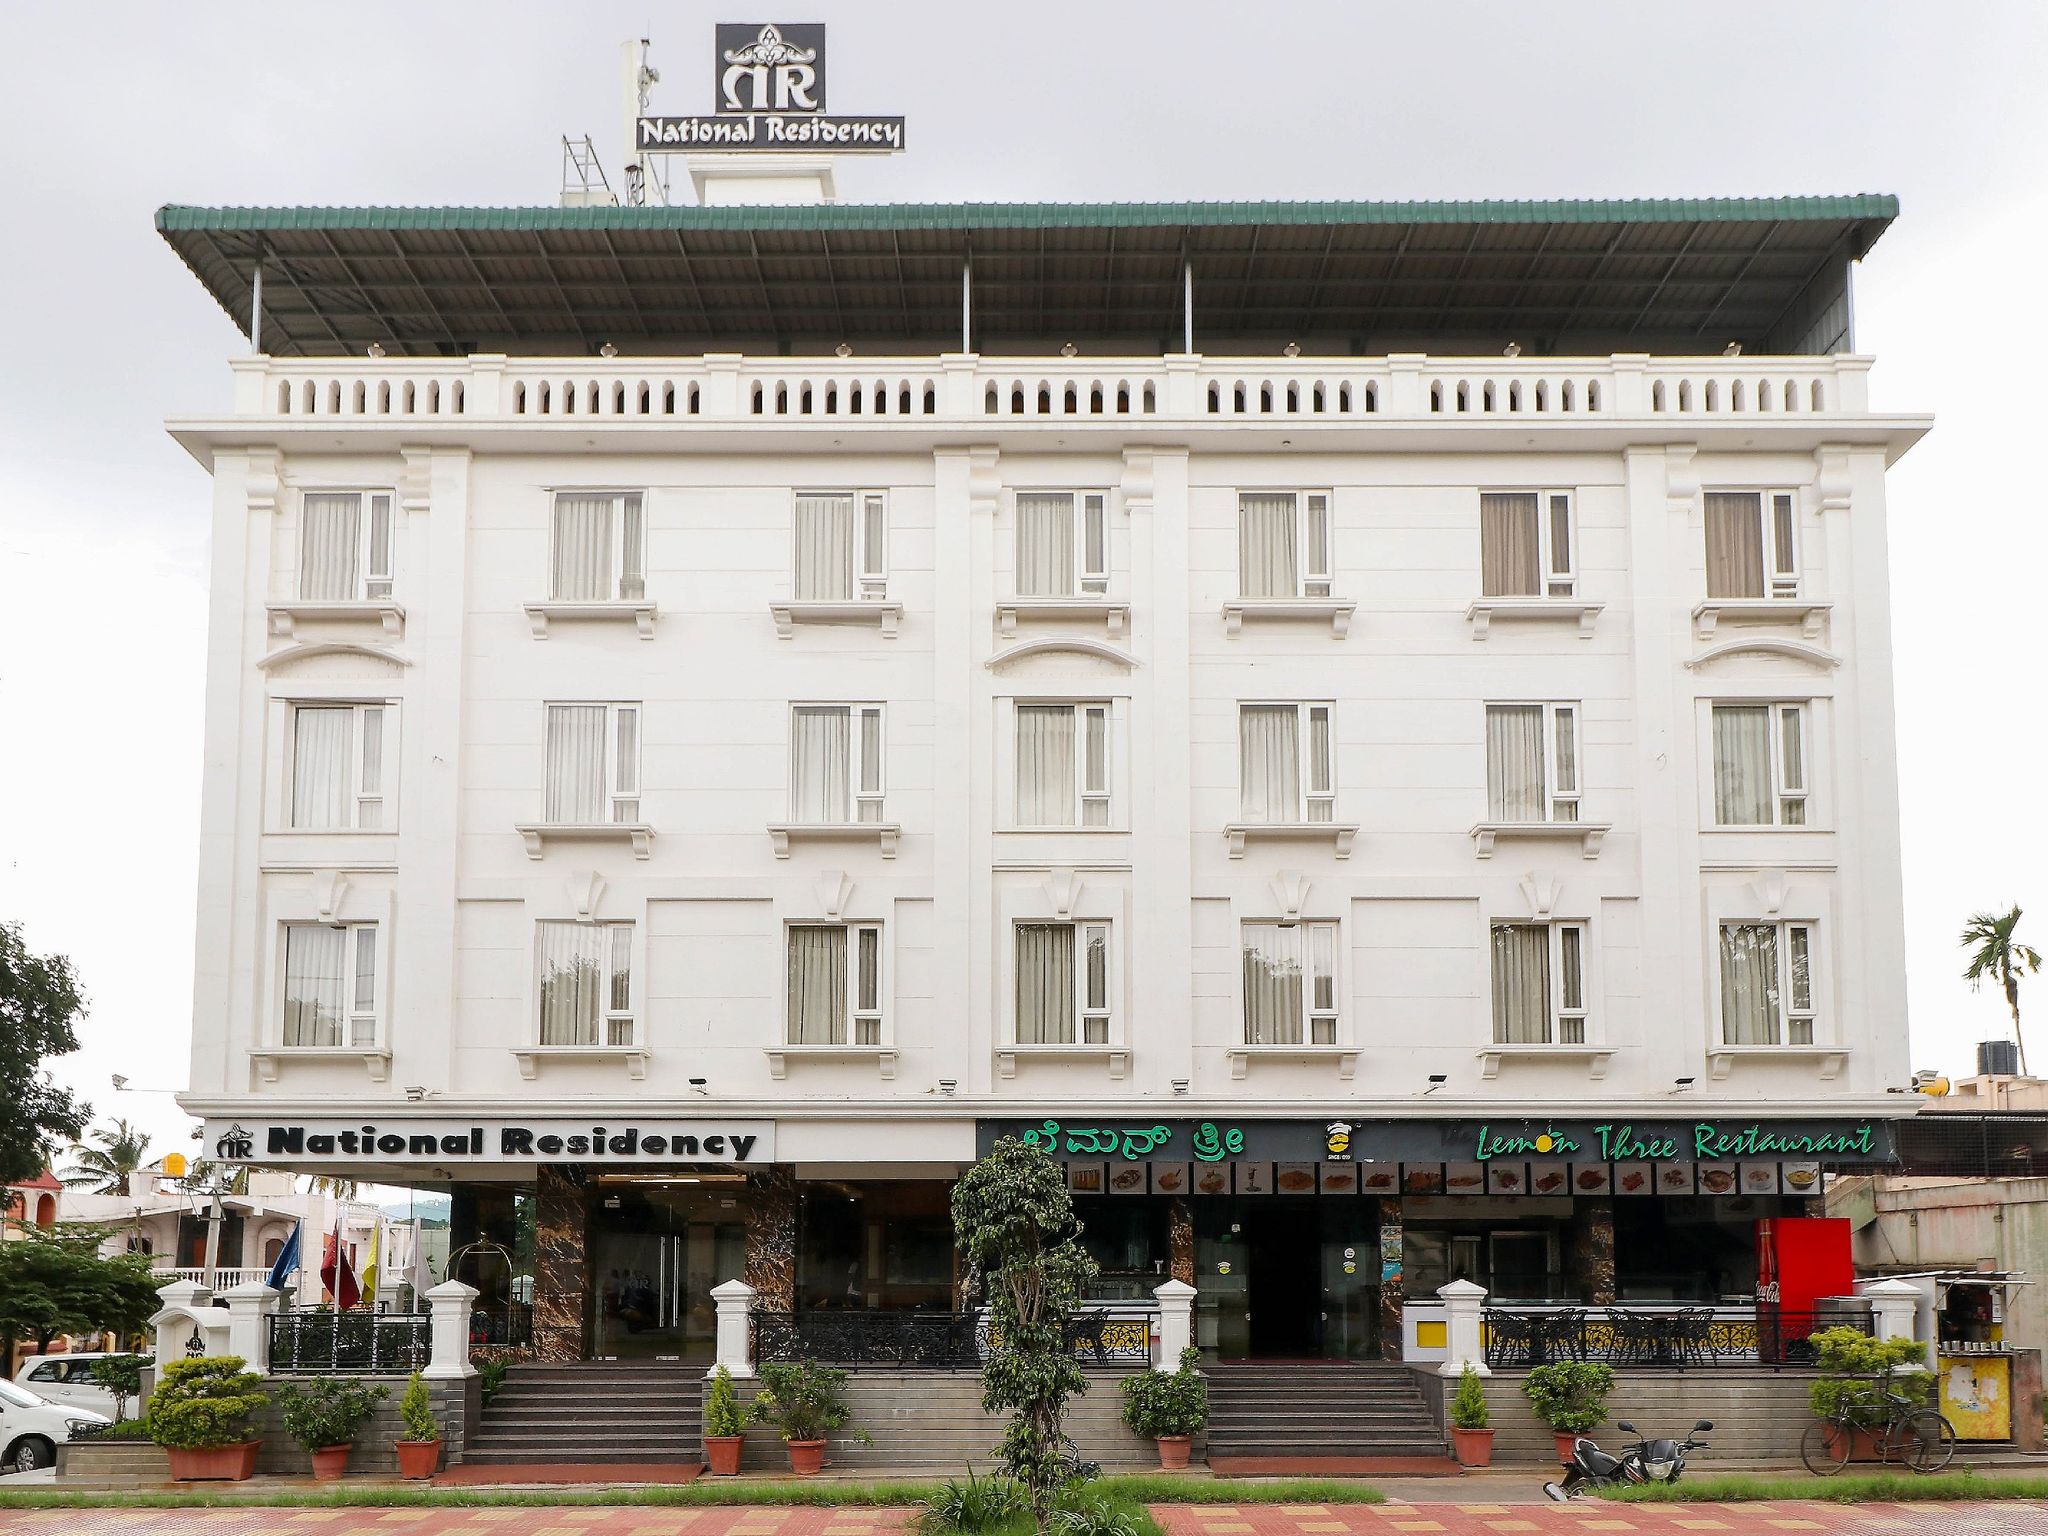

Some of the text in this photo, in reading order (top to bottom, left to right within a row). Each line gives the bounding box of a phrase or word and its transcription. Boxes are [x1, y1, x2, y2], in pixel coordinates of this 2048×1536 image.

[639, 115, 900, 147] National Residency
[268, 1126, 757, 1160] National Residency
[1476, 1125, 1580, 1160] Lemon
[1594, 1125, 1678, 1160] Three
[1694, 1125, 1875, 1158] Restaurant
